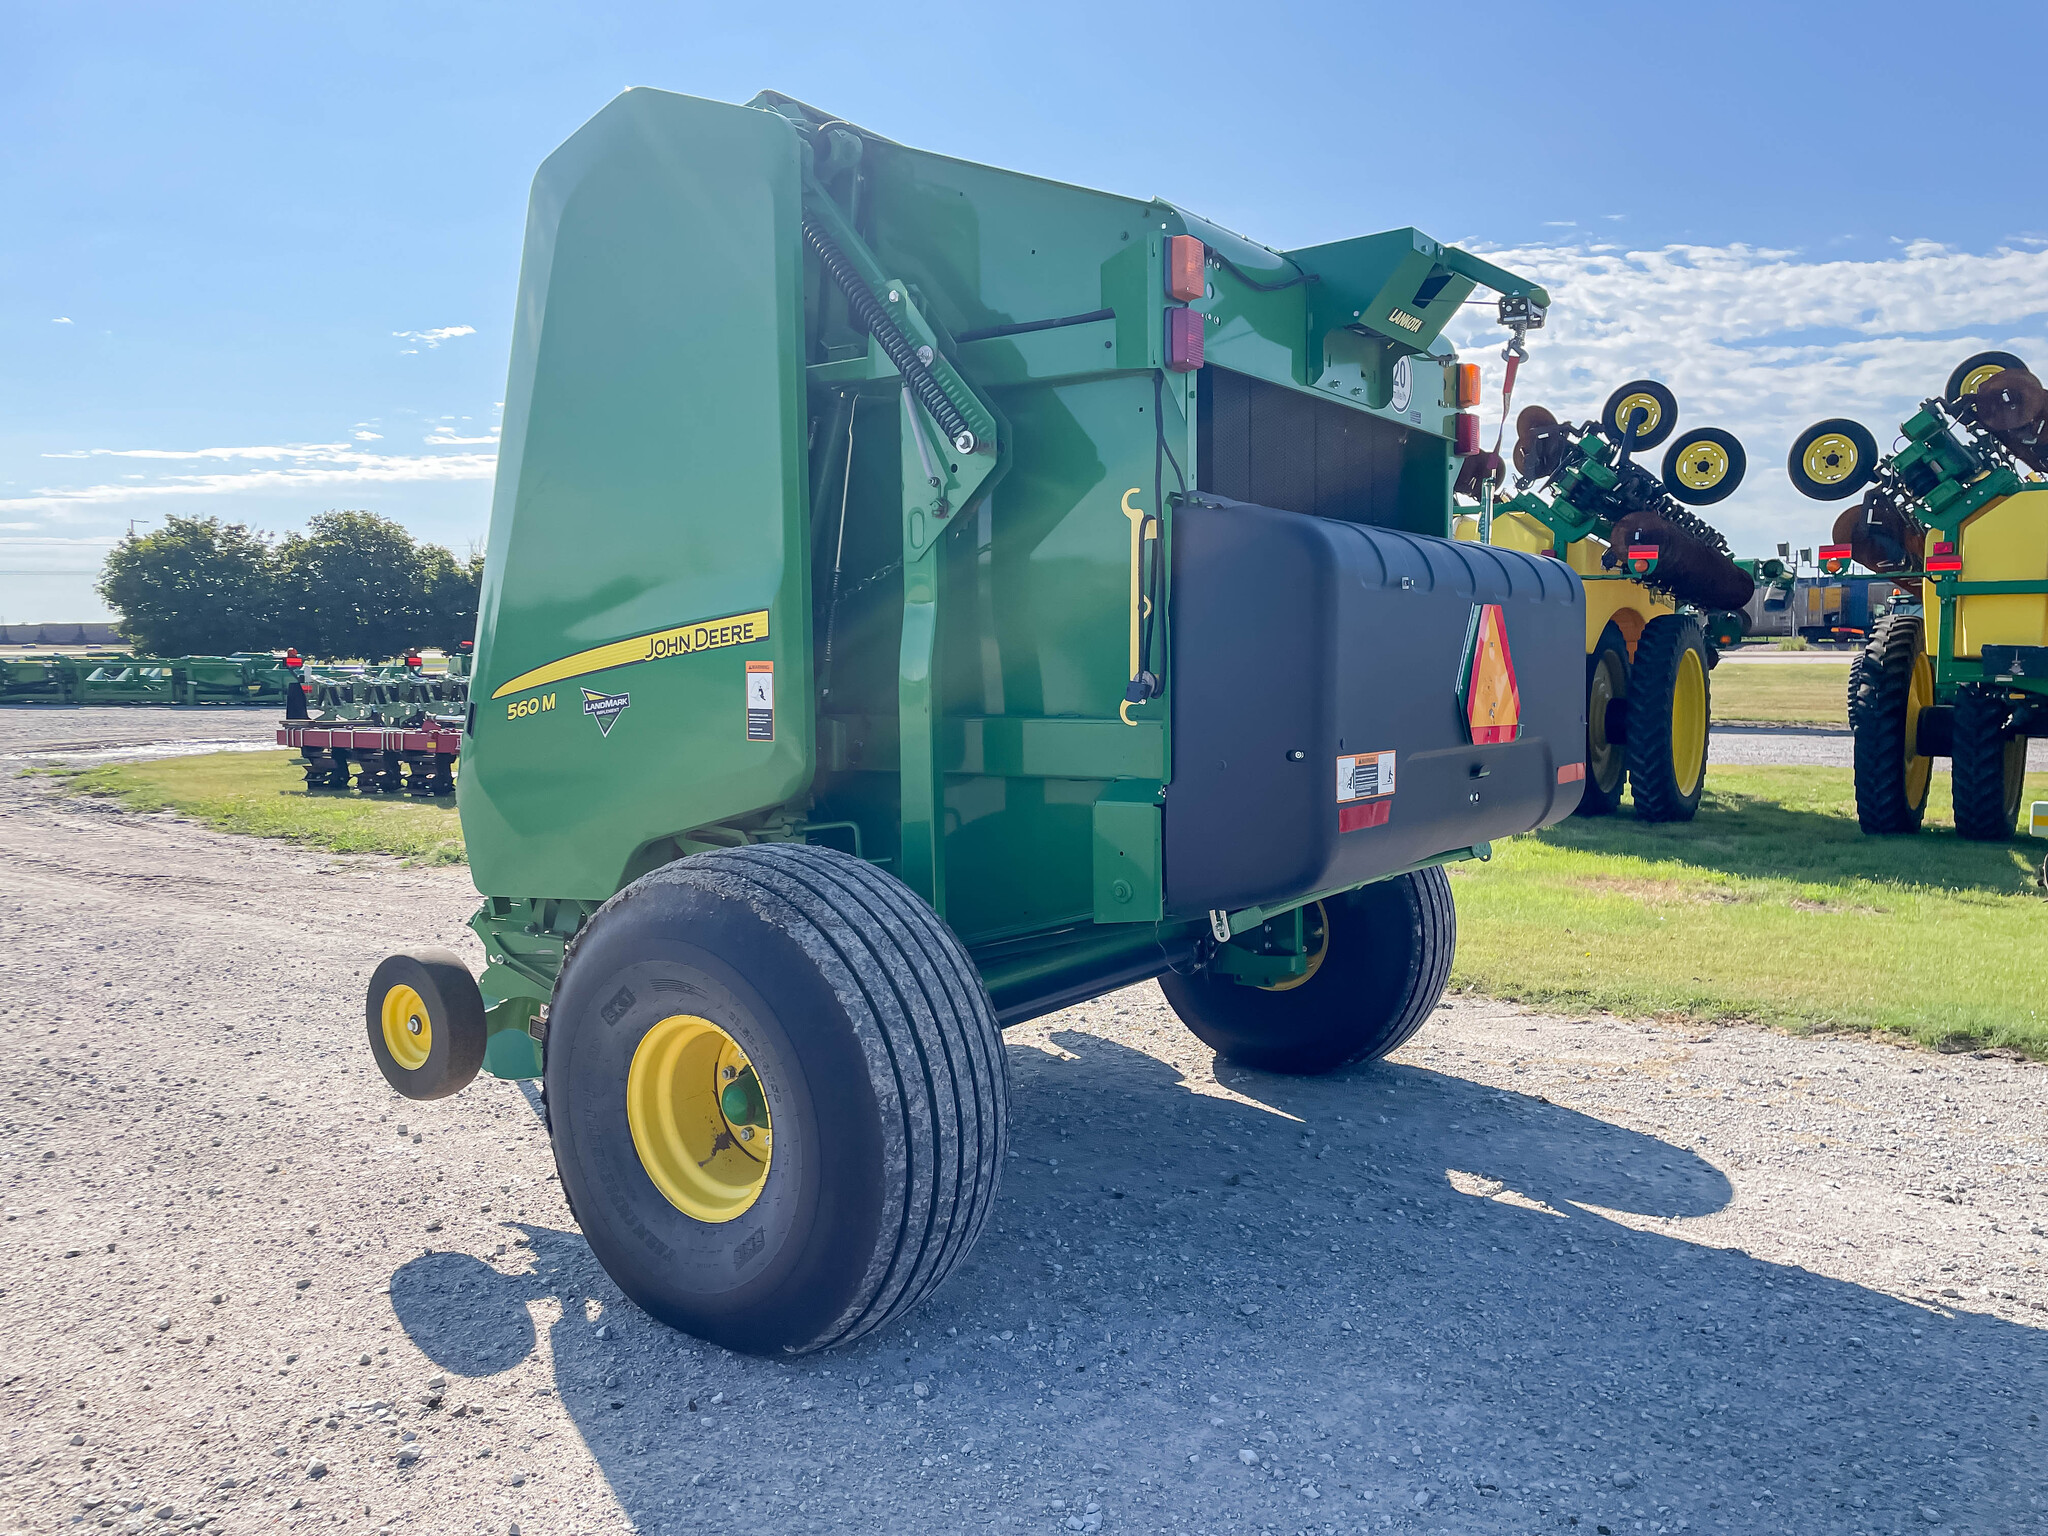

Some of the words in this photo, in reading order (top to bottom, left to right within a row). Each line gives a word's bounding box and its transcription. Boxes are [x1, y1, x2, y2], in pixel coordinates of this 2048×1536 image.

[1388, 308, 1423, 333] LANKOTA
[644, 633, 691, 659] JOHN
[694, 622, 754, 648] DEERE
[507, 697, 540, 721] 560
[541, 691, 556, 712] M
[585, 697, 628, 711] LANDMARK
